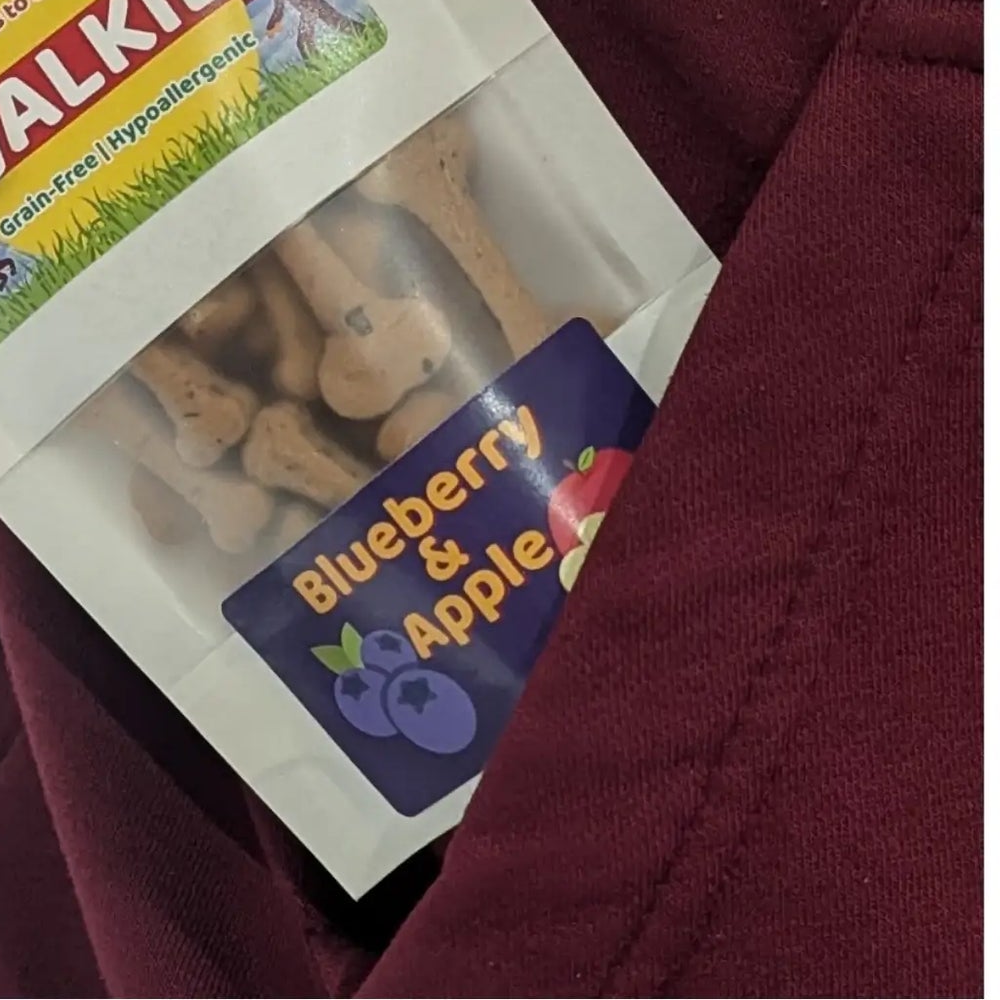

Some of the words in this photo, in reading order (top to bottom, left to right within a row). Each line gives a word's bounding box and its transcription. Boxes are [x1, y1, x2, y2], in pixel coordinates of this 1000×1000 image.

[0, 154, 100, 237] Grain-Free
[106, 32, 258, 151] Hypoallergenic
[292, 404, 542, 615] Blueberry
[417, 535, 470, 582] &
[402, 528, 556, 660] Apple
